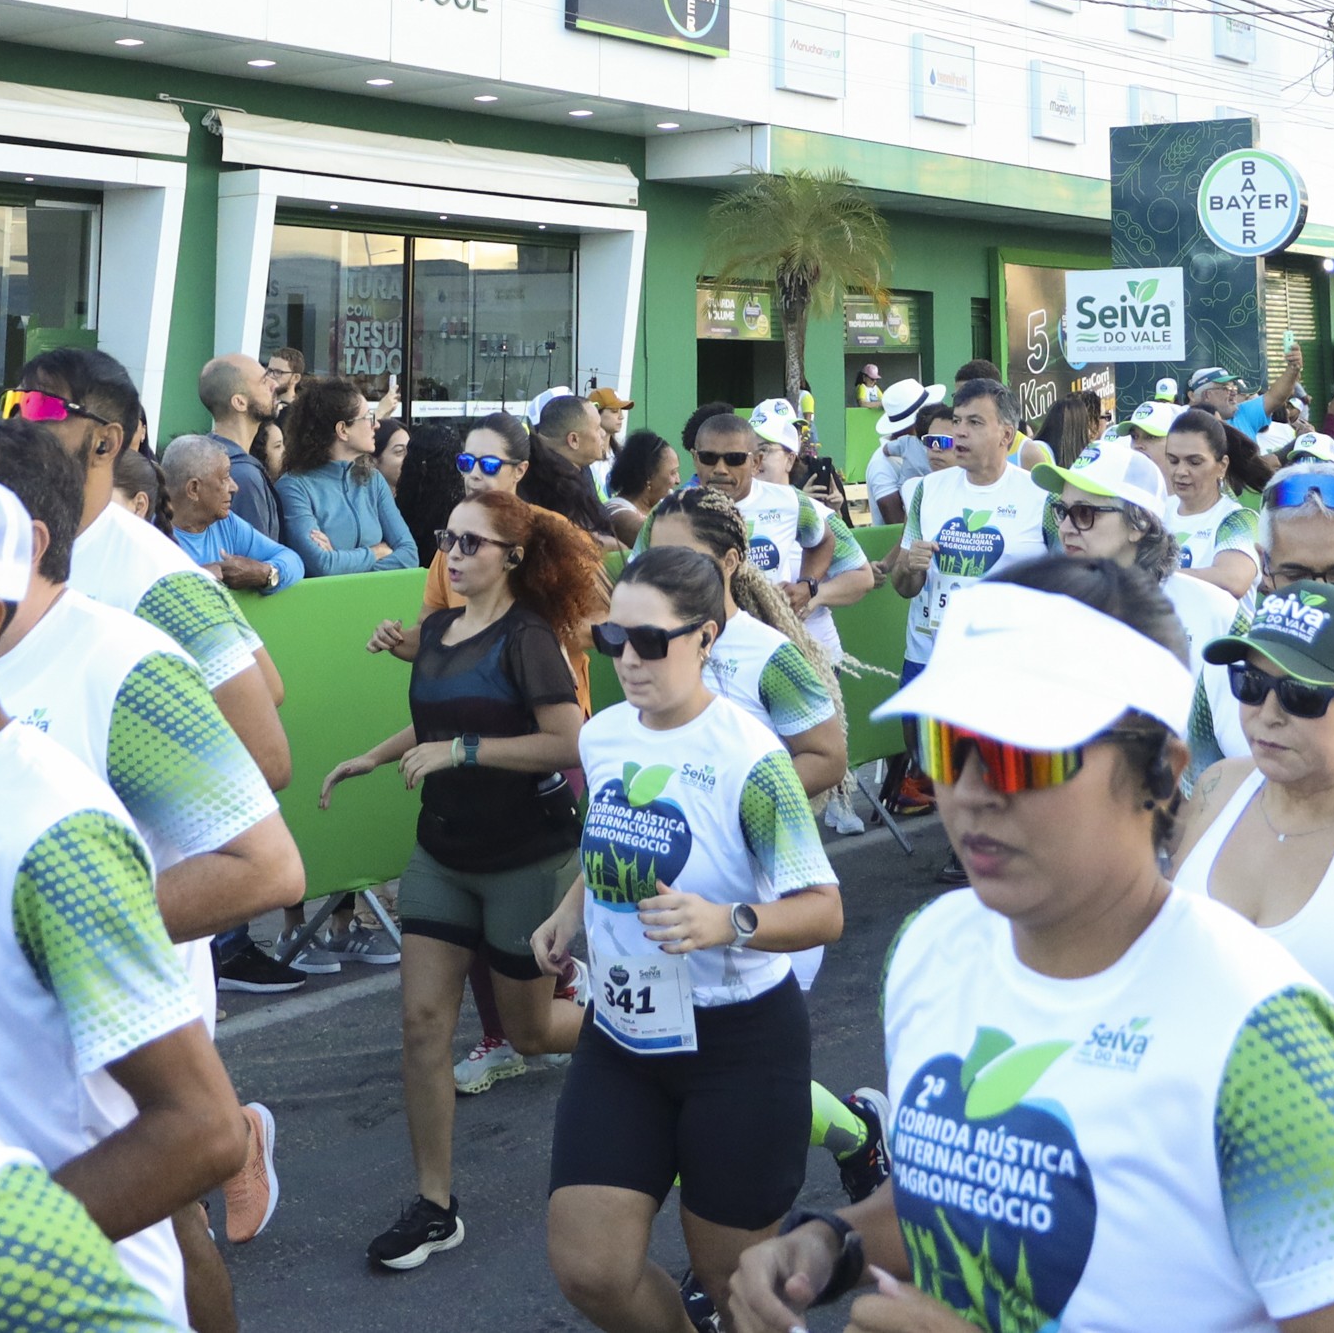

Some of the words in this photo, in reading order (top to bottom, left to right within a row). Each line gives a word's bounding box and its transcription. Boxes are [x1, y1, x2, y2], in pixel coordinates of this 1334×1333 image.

[1210, 194, 1288, 210] BAYER
[1076, 295, 1171, 330] Seiva
[1027, 309, 1049, 374] 5
[1104, 332, 1125, 343] DO
[1131, 331, 1171, 343] VALE
[1020, 379, 1056, 421] Km
[940, 535, 993, 546] INTERNACIONAL
[942, 529, 971, 539] CORRIDA
[972, 531, 1001, 541] RÚSTICA
[1266, 614, 1282, 624] DO
[1285, 617, 1317, 635] VALE
[681, 763, 715, 785] Seiva
[588, 814, 673, 842] INTERNACIONAL
[591, 802, 632, 820] CORRIDA
[634, 810, 686, 834] RÚSTICA
[589, 826, 671, 855] AGRONEGÓCIO
[1085, 1023, 1150, 1055] Seiva
[898, 1107, 970, 1149] CORRIDA
[974, 1125, 1076, 1177] RÚSTICA
[895, 1132, 1053, 1201] INTERNACIONAL
[899, 1162, 1052, 1233] AGRONEGÓCIO
